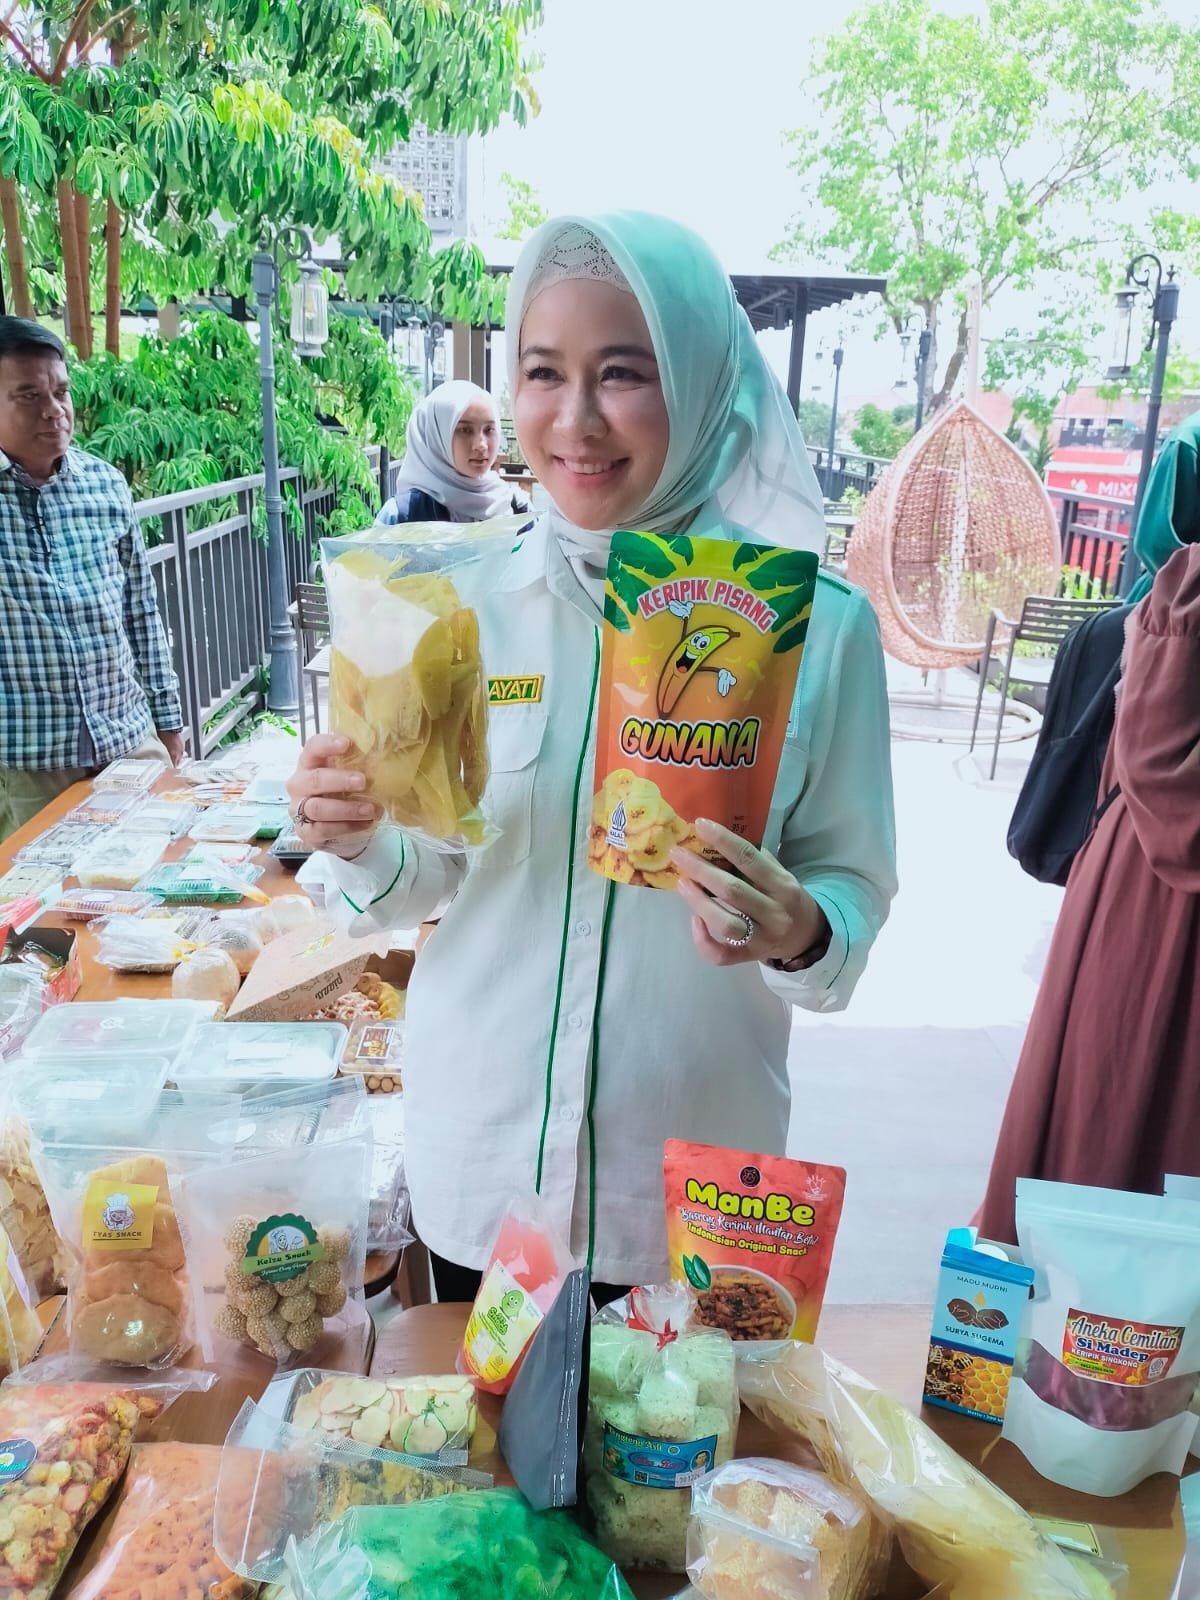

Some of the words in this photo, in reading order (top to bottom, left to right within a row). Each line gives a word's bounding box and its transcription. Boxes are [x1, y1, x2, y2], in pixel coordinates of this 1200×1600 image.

[638, 579, 710, 617] KERIPIK
[713, 581, 778, 632] PISANG
[488, 679, 537, 700] AYATI
[621, 718, 761, 768] GUNANA
[686, 1178, 815, 1226] ManBe
[687, 1222, 736, 1247] Indonesian
[738, 1239, 776, 1253] Original
[717, 1217, 755, 1234] Keripik
[755, 1222, 792, 1242] Mantap
[285, 1249, 312, 1260] Snack
[957, 1276, 981, 1286] MADU
[982, 1281, 1008, 1293] MURNI
[945, 1325, 969, 1337] SURYA
[971, 1332, 1005, 1346] SUGEMA
[1071, 1317, 1118, 1342] Aneka
[1121, 1326, 1177, 1349] Cemilan
[1071, 1348, 1099, 1360] KERIPIK
[1101, 1355, 1138, 1368] SINGKONG
[1076, 1337, 1093, 1350] Si
[1097, 1342, 1149, 1362] Madep
